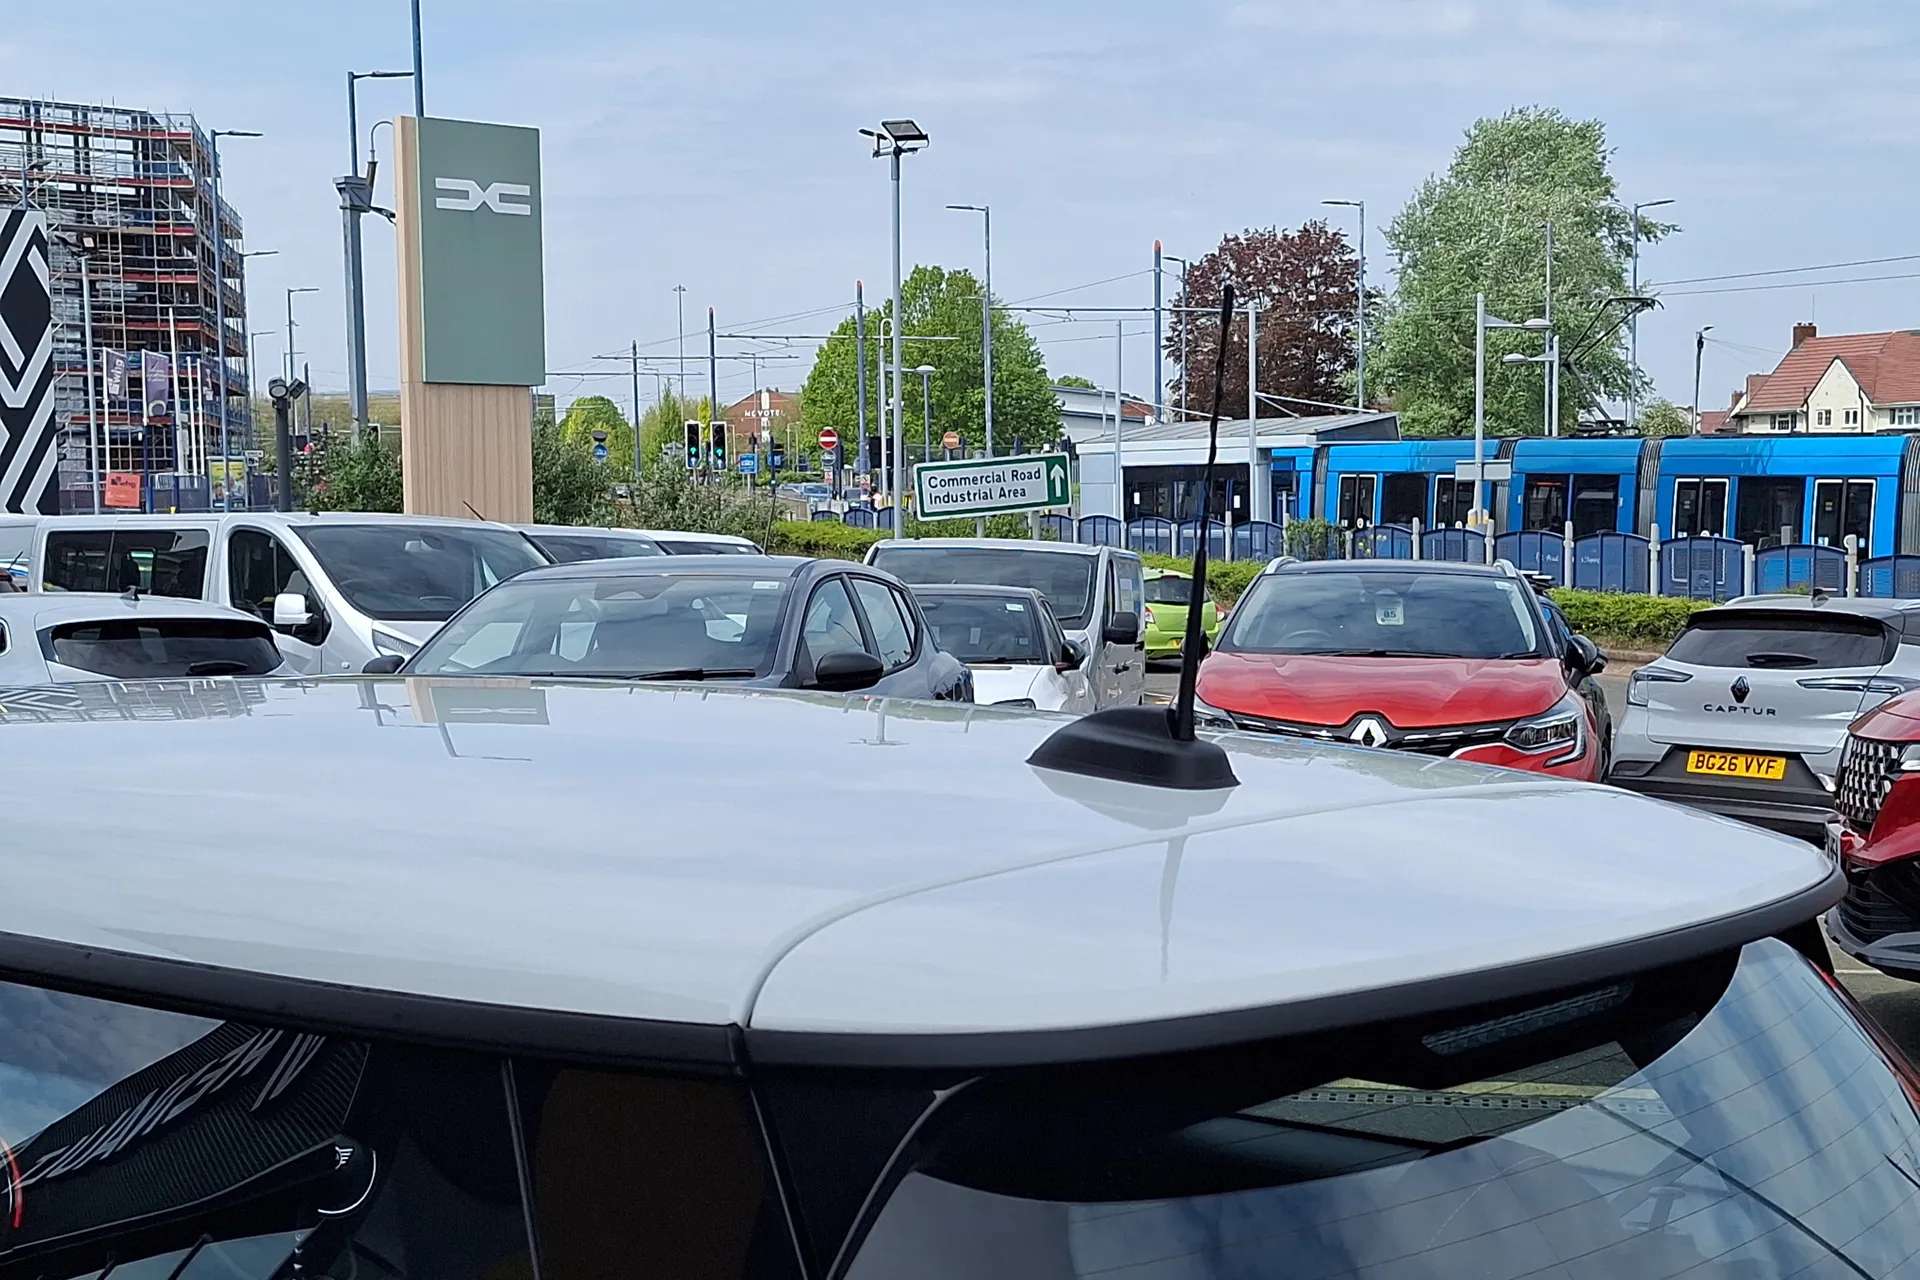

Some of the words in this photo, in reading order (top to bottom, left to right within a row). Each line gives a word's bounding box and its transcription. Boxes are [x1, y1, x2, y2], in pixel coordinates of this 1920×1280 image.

[928, 471, 1006, 489] Commercial
[1011, 467, 1041, 482] Road
[929, 487, 993, 505] Industrial
[998, 486, 1026, 499] Area
[1703, 704, 1777, 716] CAPTUR
[1694, 753, 1738, 772] BG26
[1744, 756, 1778, 775] VYF
